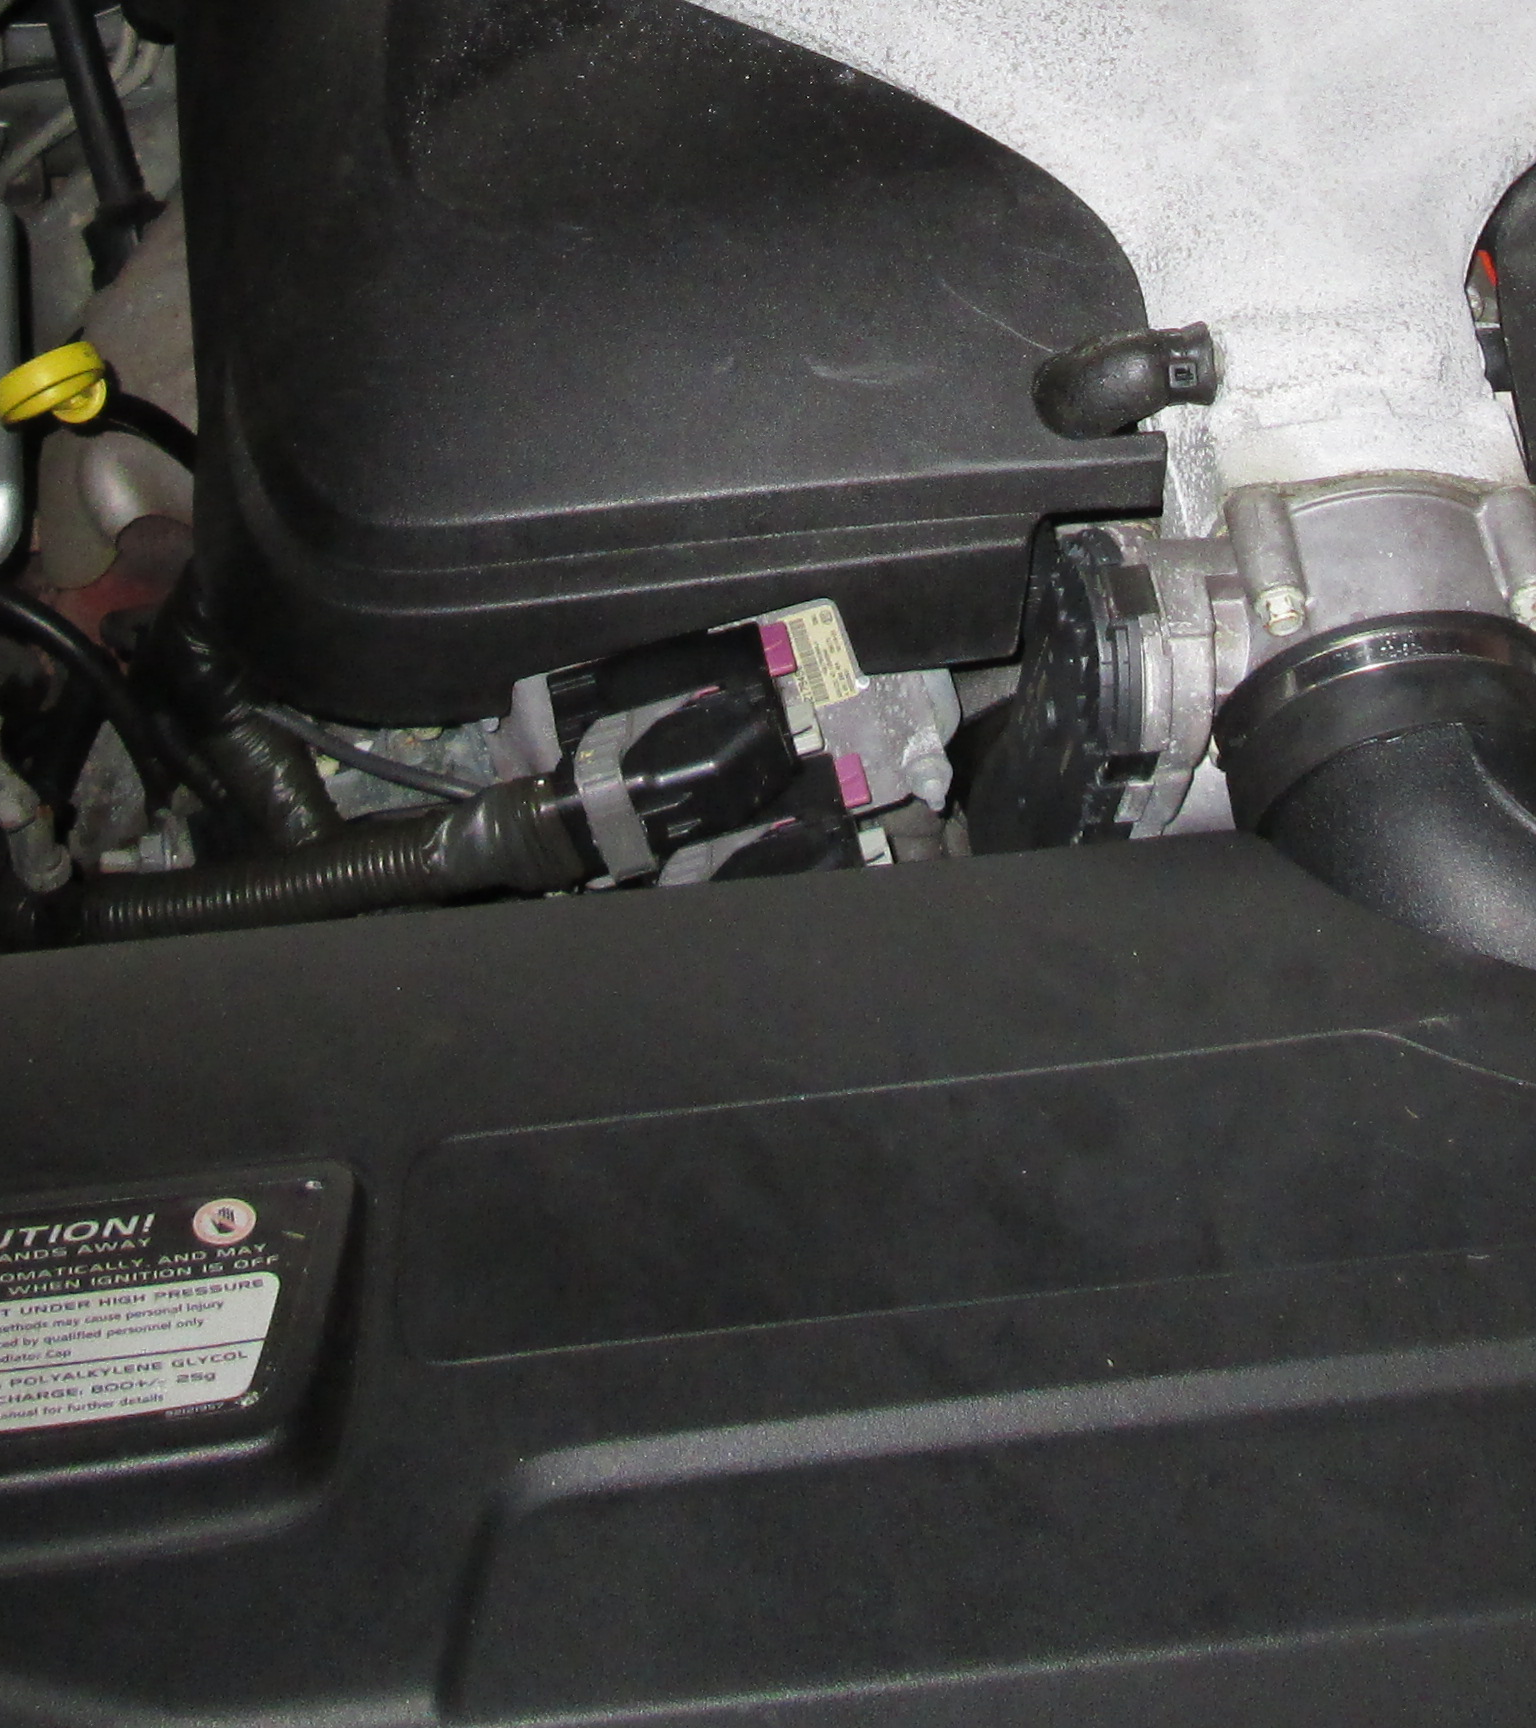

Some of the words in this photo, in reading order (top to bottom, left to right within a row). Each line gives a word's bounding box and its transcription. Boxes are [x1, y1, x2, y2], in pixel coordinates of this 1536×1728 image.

[77, 1237, 152, 1255] AWAY
[158, 1250, 206, 1265] AND
[216, 1243, 267, 1257] MAY
[8, 1278, 80, 1297] WHEN
[91, 1266, 192, 1287] IGNITION
[203, 1262, 224, 1273] IS
[234, 1254, 280, 1270] OFF
[19, 1300, 90, 1317] UNDER
[99, 1294, 146, 1307] HIGH
[154, 1279, 264, 1300] PRESSURE
[52, 1317, 80, 1328] may
[84, 1312, 121, 1324] cause
[125, 1303, 183, 1321] personal
[21, 1336, 39, 1348] by
[43, 1328, 102, 1345] qualified
[106, 1321, 171, 1338] personnel
[175, 1317, 205, 1330] only
[45, 1349, 72, 1362] Cap
[10, 1361, 164, 1387] POLYALKYLENE
[170, 1350, 249, 1369] GLYCOL
[42, 1403, 63, 1416] for
[67, 1399, 115, 1414] further
[119, 1393, 165, 1407] details
